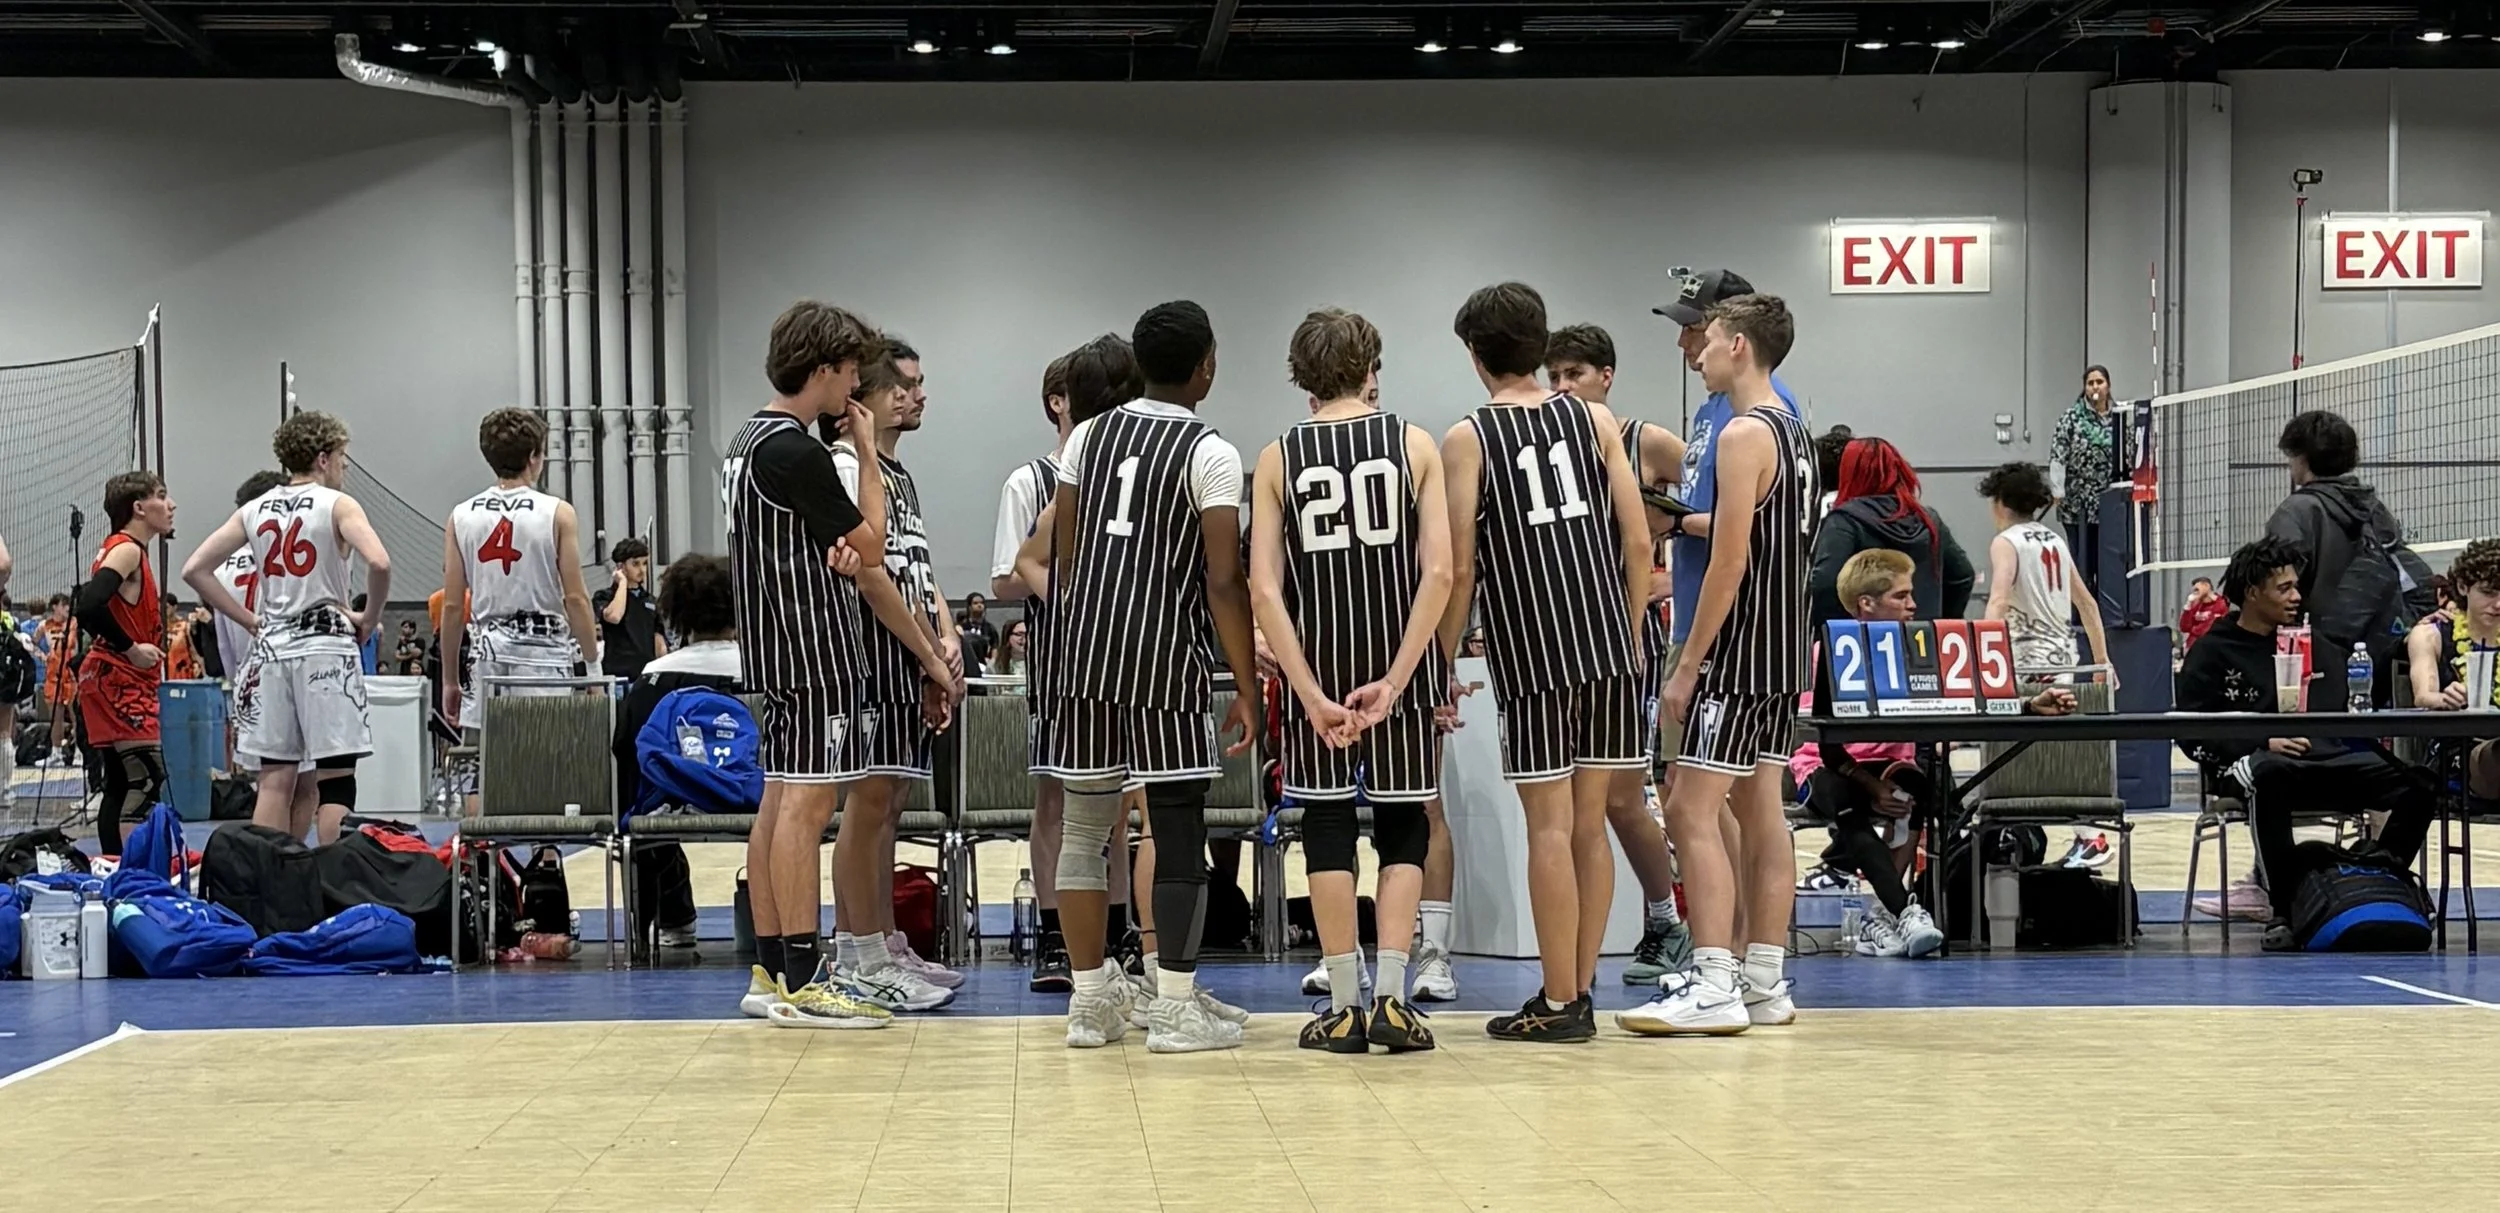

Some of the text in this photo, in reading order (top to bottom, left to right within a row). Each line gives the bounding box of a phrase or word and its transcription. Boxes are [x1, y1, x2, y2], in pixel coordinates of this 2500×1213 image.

[1844, 236, 1977, 285] EXIT
[2337, 230, 2469, 279] EXIT
[471, 497, 534, 512] FEVA
[1106, 456, 1140, 536] 1
[1296, 457, 1399, 553] 20
[1516, 439, 1590, 525] 11
[225, 554, 256, 571] FEV
[256, 516, 317, 578] 26
[478, 514, 522, 576] 4
[2041, 545, 2062, 592] 11
[234, 571, 259, 614] 7
[1914, 629, 1927, 658] 1
[1941, 631, 2008, 690] 25
